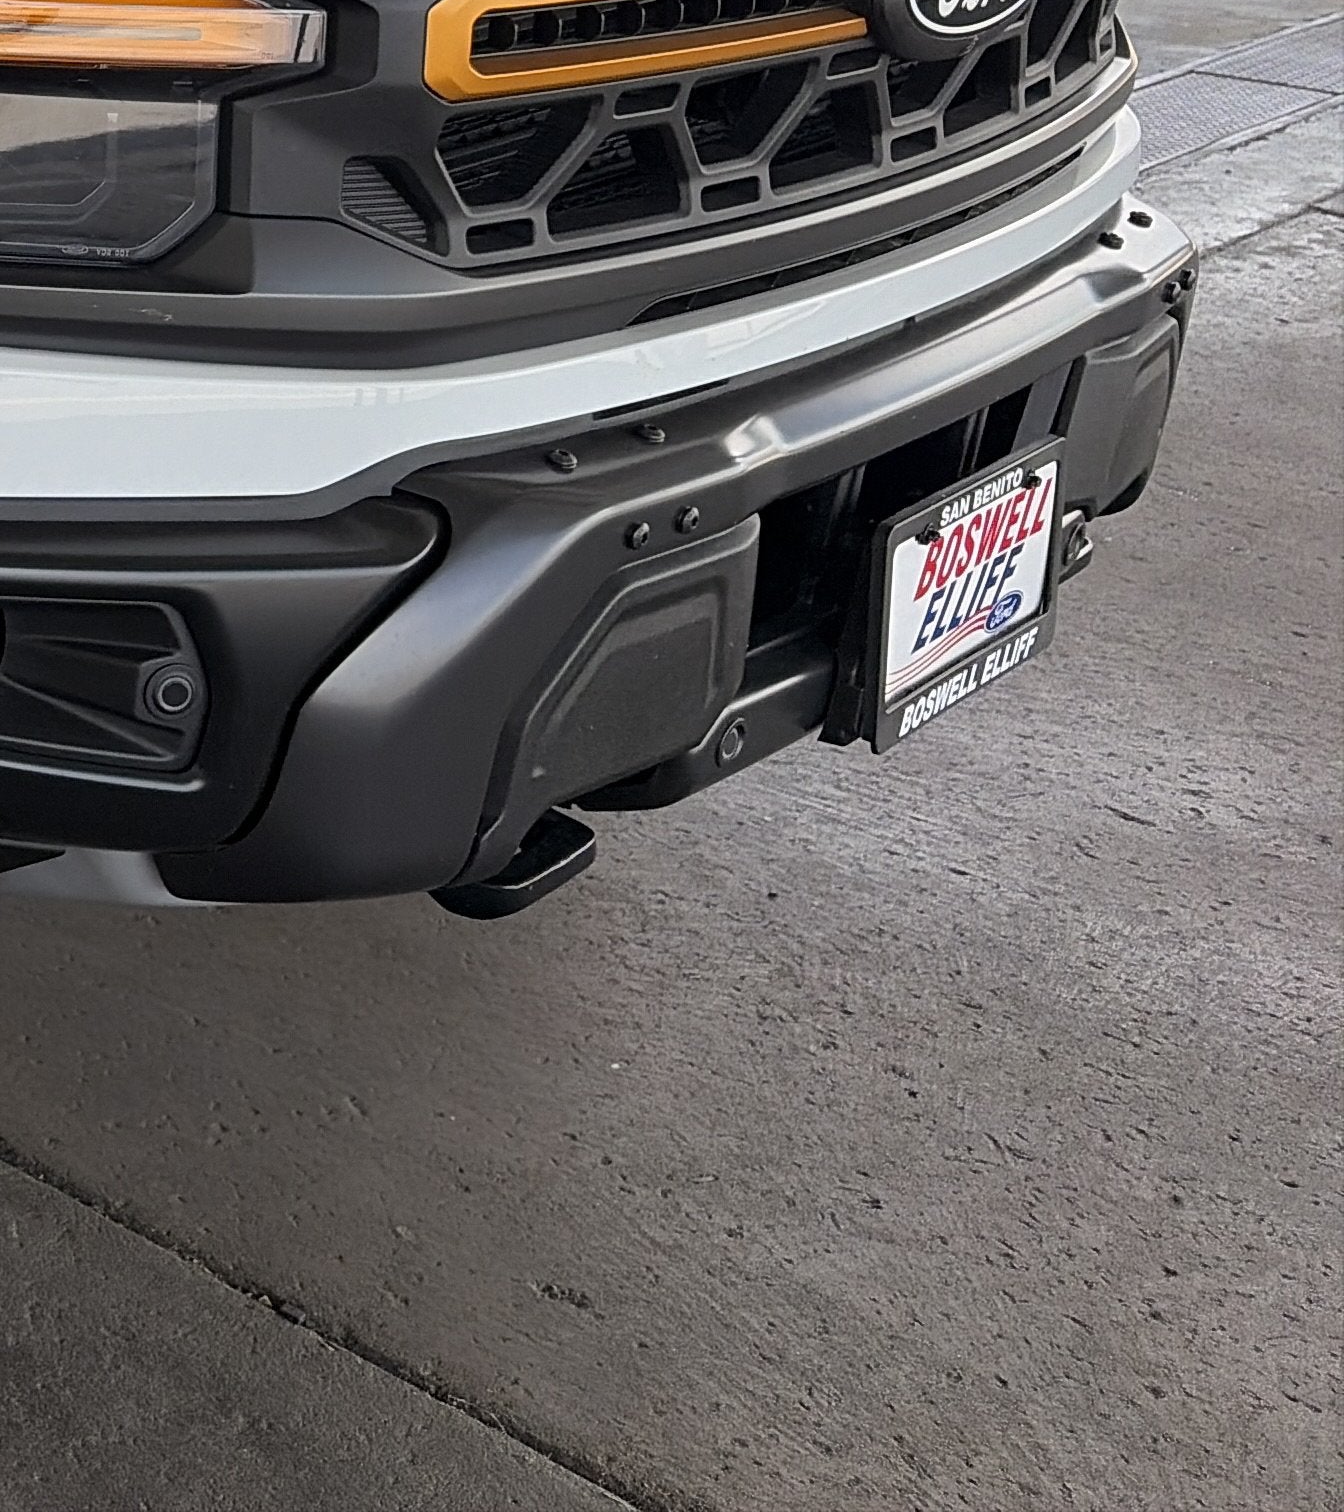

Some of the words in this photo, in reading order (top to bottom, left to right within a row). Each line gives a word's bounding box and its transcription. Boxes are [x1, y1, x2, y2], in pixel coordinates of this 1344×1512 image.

[914, 477, 1053, 602] BOSWELL
[940, 496, 971, 527] SAN
[972, 466, 1023, 512] BENITO
[911, 543, 1025, 655] ELLIFF
[989, 596, 1018, 629] Ford
[899, 663, 980, 738] BOSWELL
[979, 626, 1039, 686] ELLIFF
